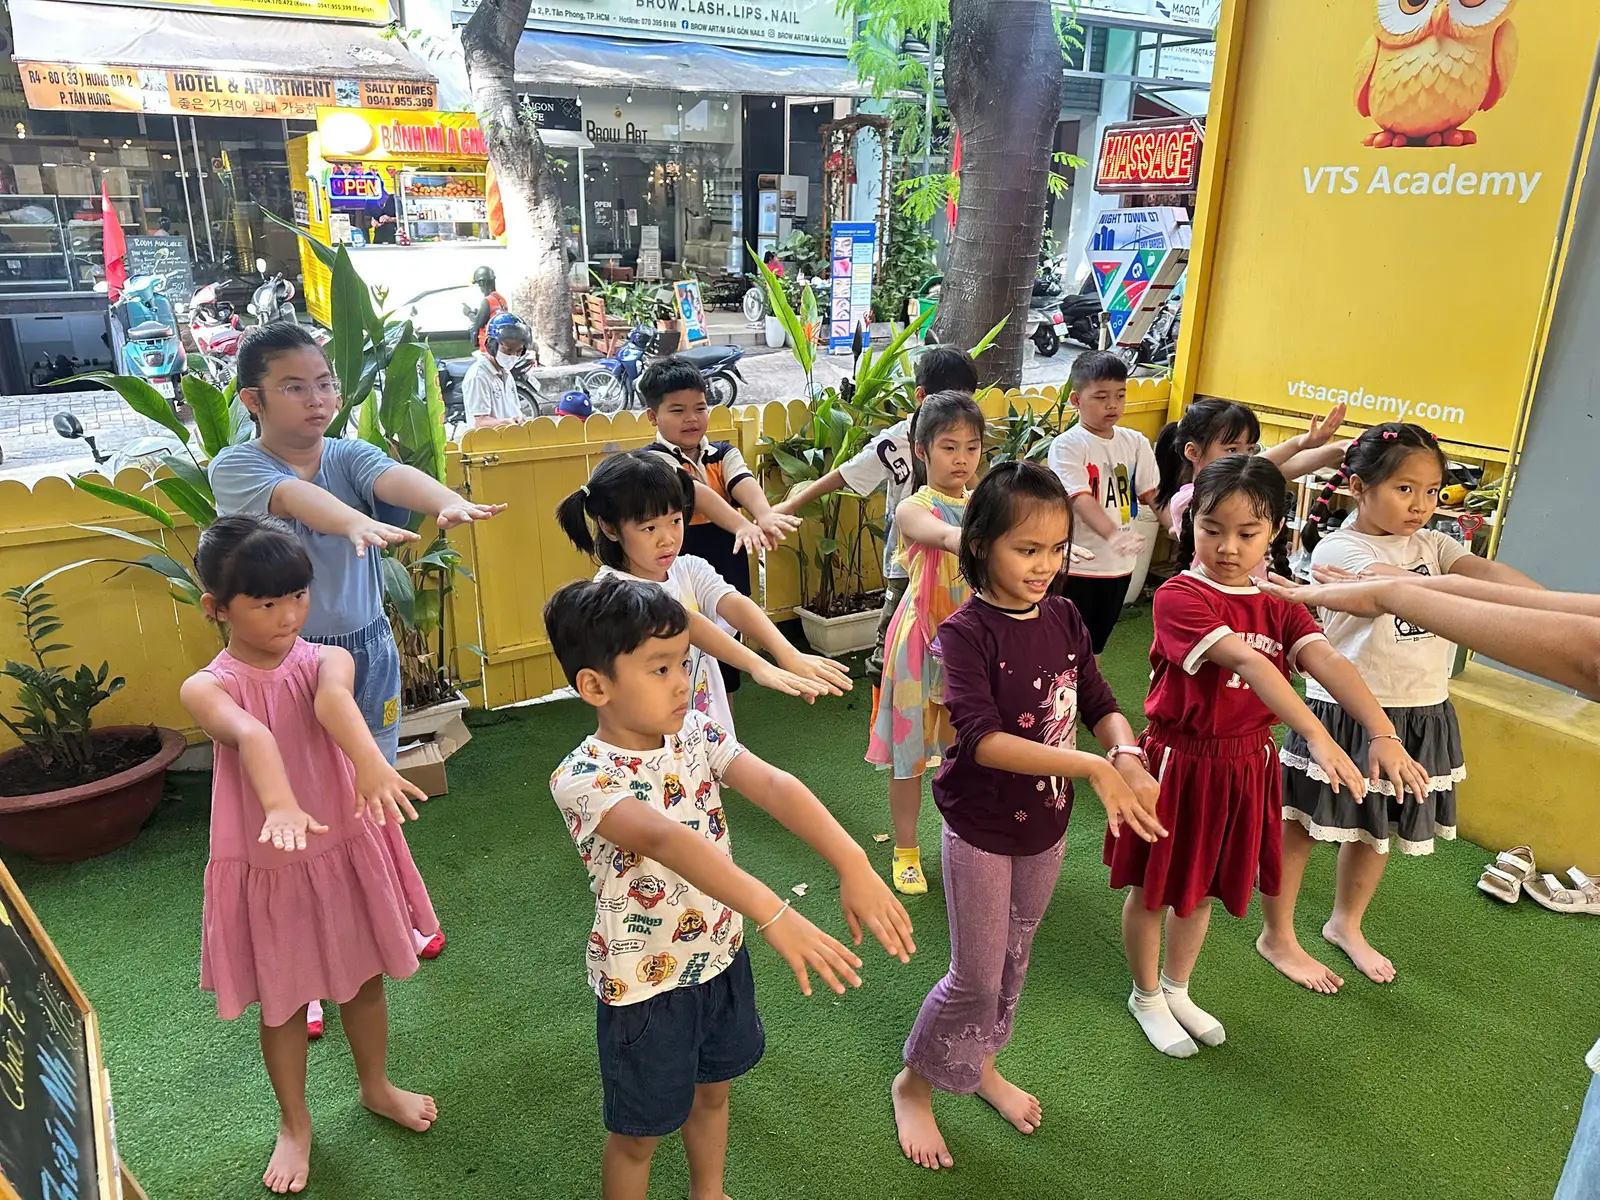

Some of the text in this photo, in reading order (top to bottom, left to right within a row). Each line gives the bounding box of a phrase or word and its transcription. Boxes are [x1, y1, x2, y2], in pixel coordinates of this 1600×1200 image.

[1172, 3, 1200, 16] MAQTA
[618, 16, 640, 25] Hotline:
[690, 22, 708, 31] BROW
[749, 29, 765, 37] NAILS
[777, 31, 793, 40] BROW
[832, 37, 847, 46] NAILS
[28, 70, 41, 84] R4
[49, 71, 60, 85] 80
[127, 76, 133, 88] 2
[173, 73, 331, 98] HOTEL & APARTMENT
[59, 91, 68, 104] P.
[69, 88, 86, 105] TÂN
[365, 83, 433, 96] SALLY HOMES
[178, 97, 204, 110] 좋은
[209, 98, 247, 112] 가격에
[253, 100, 277, 113] 임대
[367, 95, 434, 108] 0941.955.399
[519, 101, 555, 112] SAIGON
[381, 119, 422, 153] BÁNH
[446, 127, 459, 154] A
[1100, 131, 1196, 180] MASSAGE
[332, 178, 379, 196] OPEN
[1303, 163, 1542, 204] VTS Academy
[1099, 211, 1160, 224] NIGHT TOWN 07
[1287, 380, 1465, 424] vtsacademy.com
[627, 923, 652, 935] YOU
